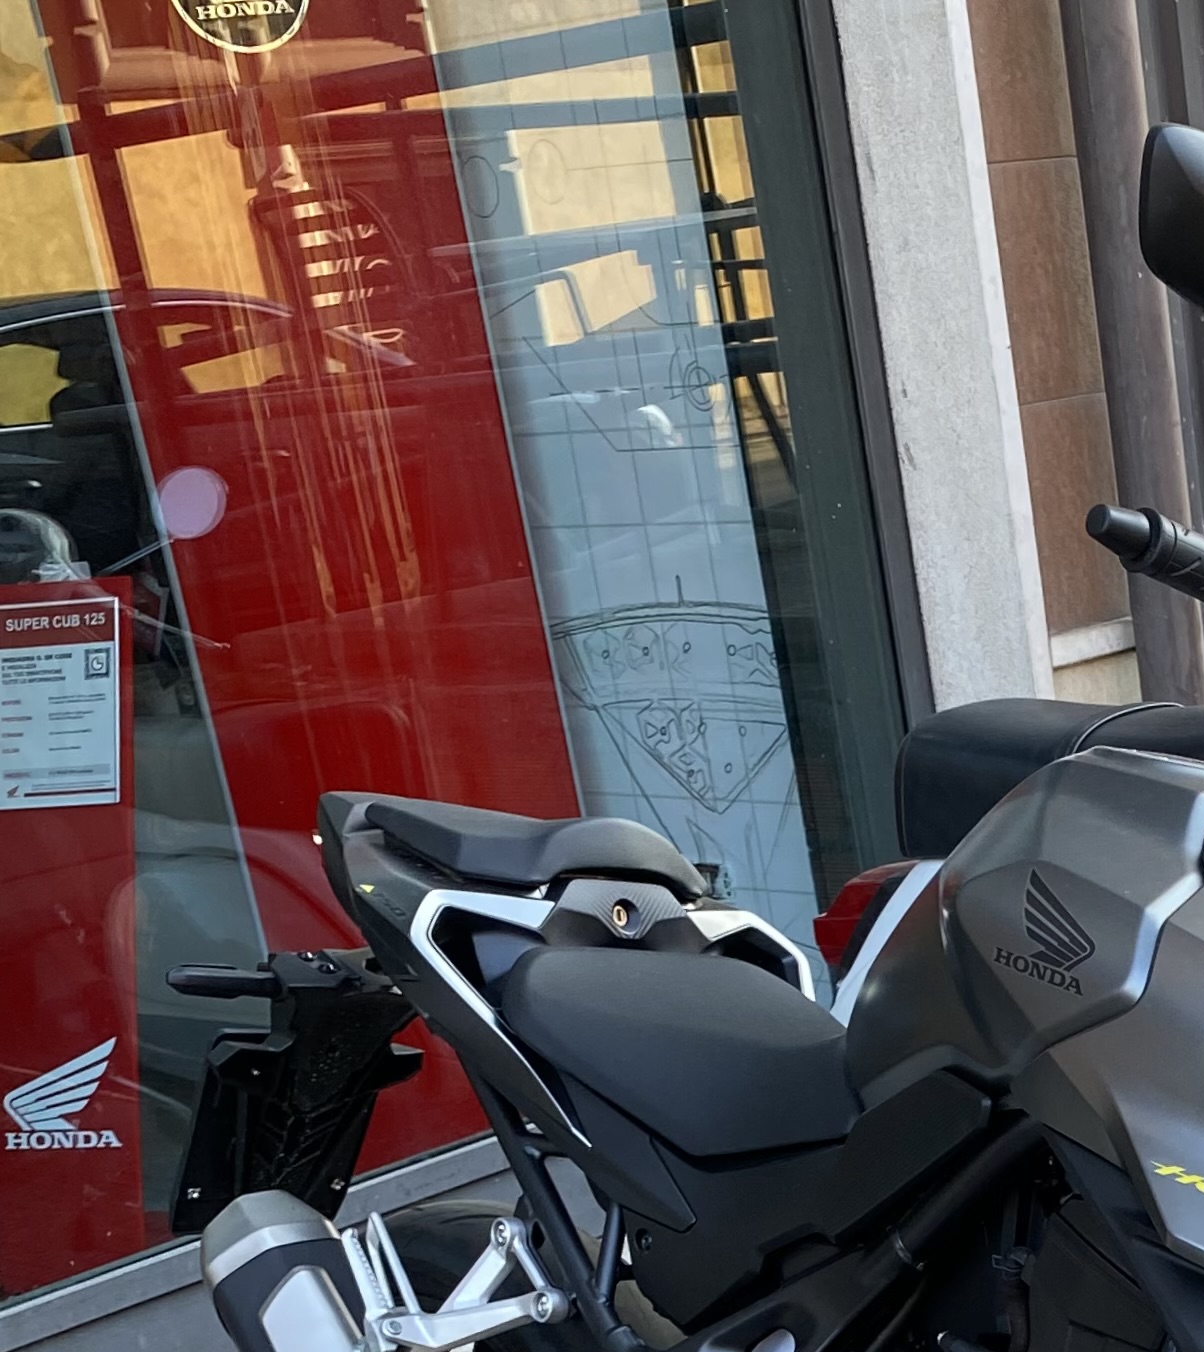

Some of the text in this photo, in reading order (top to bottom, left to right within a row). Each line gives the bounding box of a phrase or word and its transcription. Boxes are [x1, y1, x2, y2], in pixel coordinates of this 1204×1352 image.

[195, 0, 295, 20] HONDA
[5, 612, 106, 632] SUPER CUB 125
[993, 946, 1084, 997] HONDA
[5, 1129, 124, 1150] HONDA
